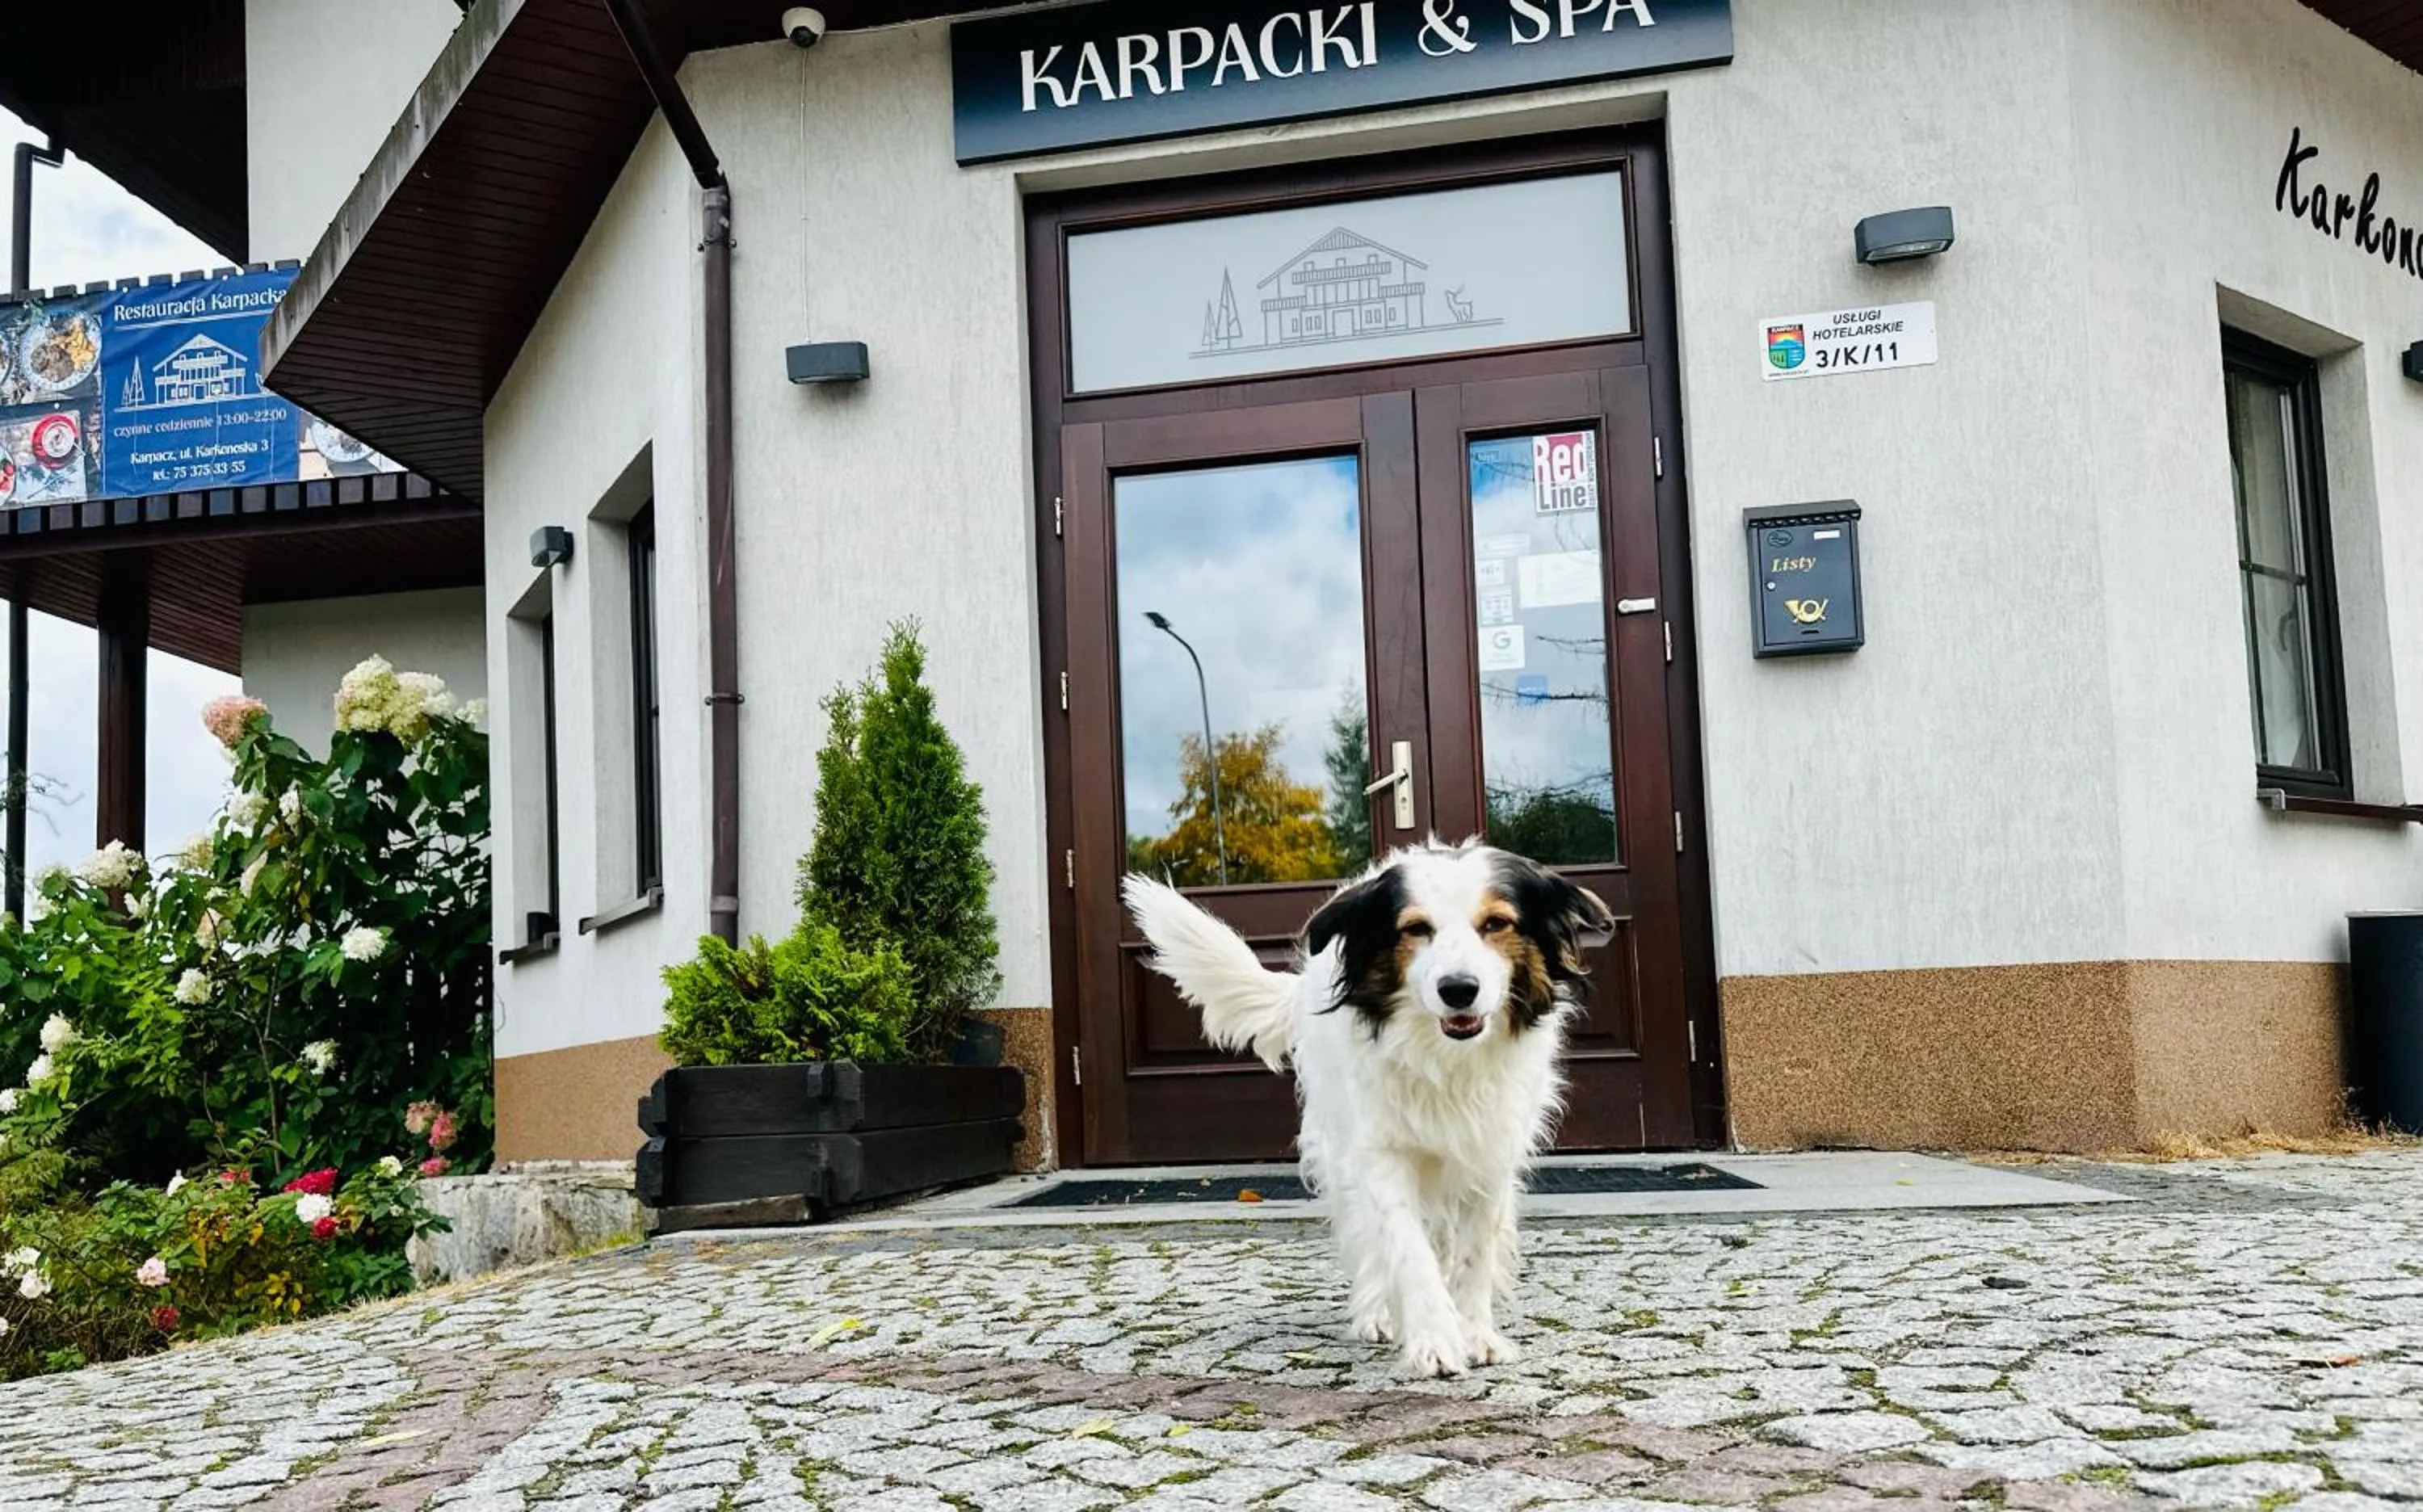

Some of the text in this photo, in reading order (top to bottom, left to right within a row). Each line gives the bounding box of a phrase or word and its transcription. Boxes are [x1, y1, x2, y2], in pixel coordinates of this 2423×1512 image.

[1021, 0, 1656, 112] KARPACKI & SPA
[114, 287, 288, 321] Restauracja Karpacka
[1833, 309, 1882, 324] USŁUGI
[1812, 321, 1904, 341] HOTELARSKIE
[1815, 342, 1898, 368] 3/K/11
[261, 439, 270, 452] 3
[174, 466, 187, 479] 75
[190, 464, 210, 478] 375
[212, 461, 227, 475] 33
[230, 460, 246, 473] 55
[1534, 433, 1585, 483] Red
[1539, 484, 1587, 510] Line
[1771, 556, 1816, 573] Listy
